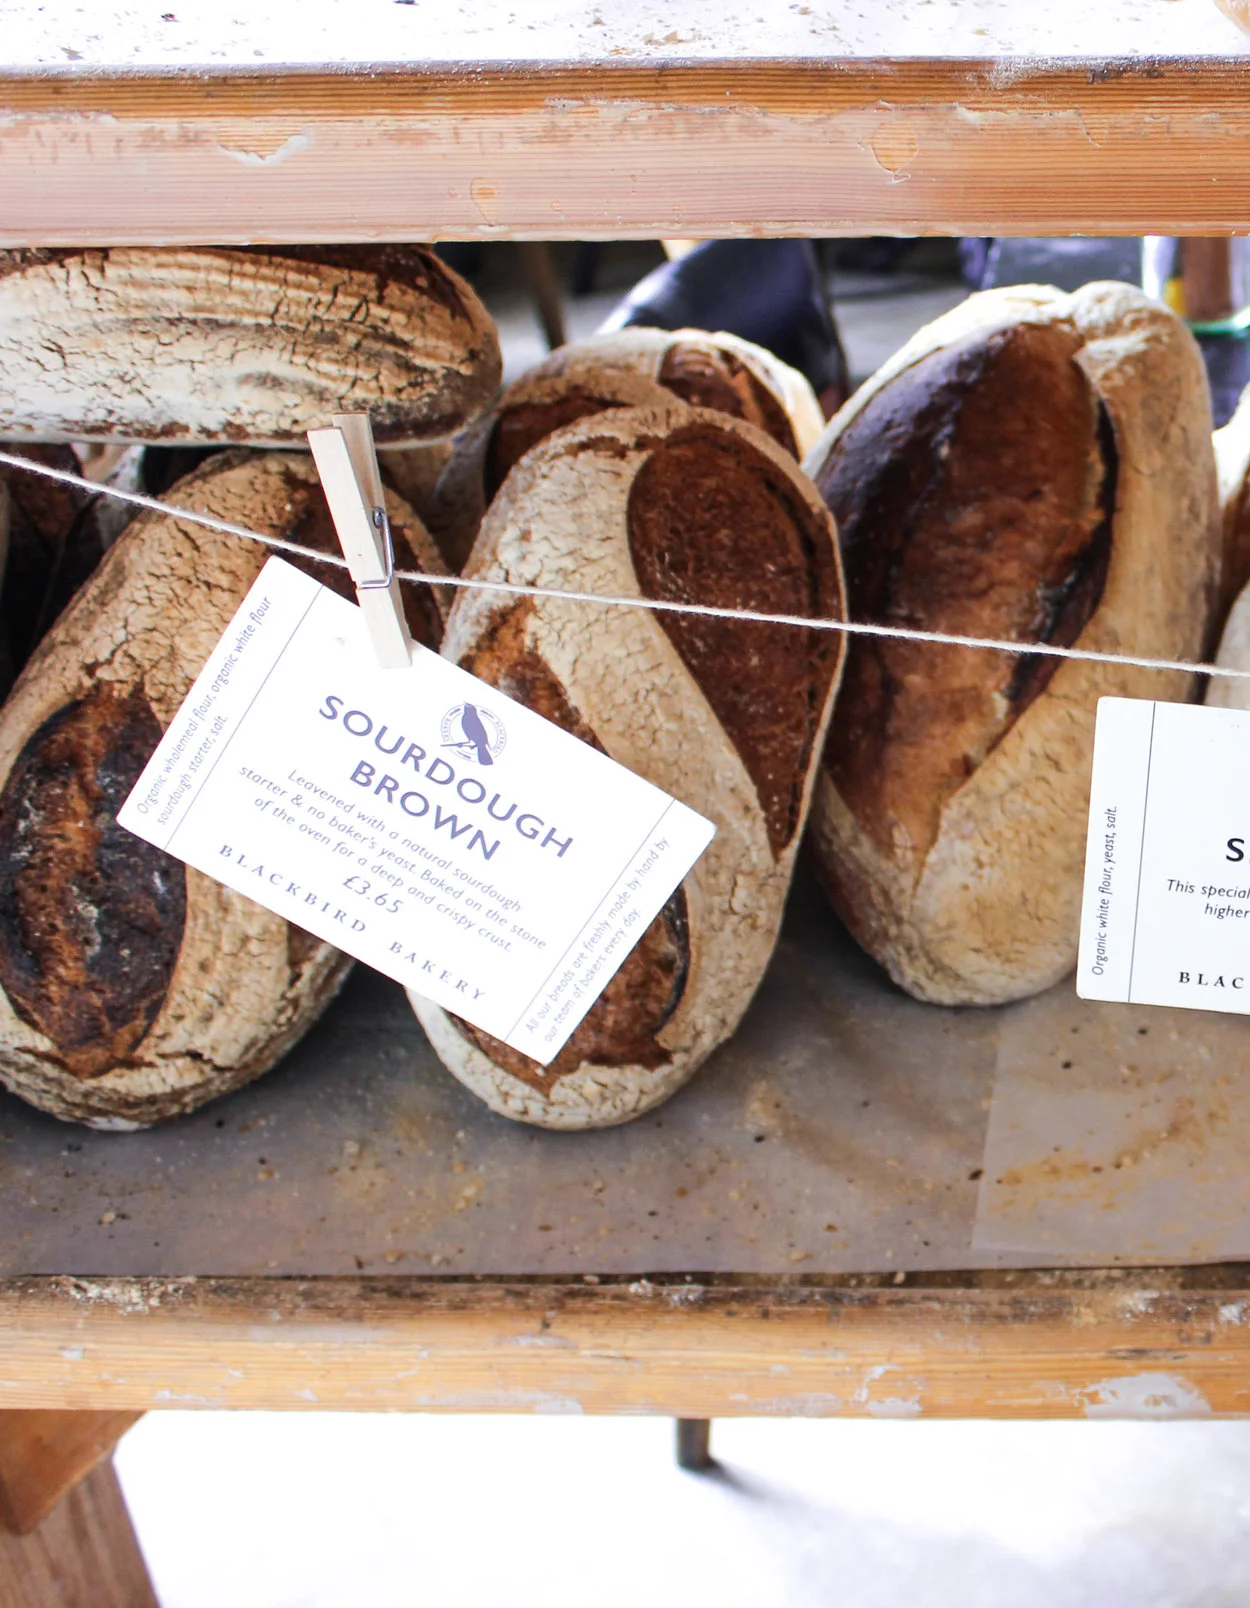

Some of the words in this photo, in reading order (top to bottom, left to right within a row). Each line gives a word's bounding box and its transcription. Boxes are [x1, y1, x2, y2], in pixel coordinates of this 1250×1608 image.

[136, 774, 167, 814] Organic
[162, 717, 199, 773] wholemeal
[191, 693, 216, 721] flour,
[210, 653, 239, 693] organic
[233, 624, 256, 653] white
[248, 596, 271, 626] flour
[156, 773, 192, 825] sourdough
[188, 736, 216, 773] starter,
[209, 715, 228, 736] salt.
[318, 695, 573, 858] SOURDOUGH
[348, 759, 501, 861] BROWN
[1103, 806, 1117, 829] salt.
[238, 766, 288, 797] starter
[289, 794, 303, 808] &
[306, 805, 326, 820] no
[327, 815, 377, 849] baker's
[419, 868, 465, 899] Baked
[464, 897, 482, 911] on
[484, 908, 507, 926] the
[509, 924, 546, 949] stone
[287, 769, 356, 813] Leavened
[356, 811, 385, 832] with
[387, 831, 399, 840] a
[400, 838, 453, 870] natural
[451, 867, 521, 912] sourdough
[1103, 832, 1117, 864] yeast,
[253, 797, 274, 811] of
[271, 807, 295, 825] the
[298, 823, 331, 845] oven
[331, 841, 355, 857] for
[356, 857, 368, 866] a
[370, 864, 404, 888] deep
[407, 886, 436, 905] and
[436, 903, 476, 930] crispy
[1097, 866, 1114, 895] flour,
[341, 875, 403, 913] £3.65
[1167, 878, 1195, 894] This
[218, 844, 366, 932] BLACKBIRD
[388, 940, 485, 1000] BAKERY
[1095, 898, 1110, 928] white
[1204, 902, 1250, 920] higher
[525, 1017, 539, 1034] All
[536, 1001, 551, 1019] our
[546, 969, 576, 1002] breads
[572, 952, 588, 969] are
[582, 919, 612, 953] freshly
[607, 891, 631, 919] made
[624, 876, 642, 891] by
[633, 848, 659, 877] hand
[652, 836, 670, 851] by
[603, 927, 627, 954] every
[578, 954, 607, 987] bakers
[1091, 931, 1108, 976] Organic
[572, 984, 585, 998] of
[553, 999, 575, 1024] team
[543, 1024, 558, 1042] our
